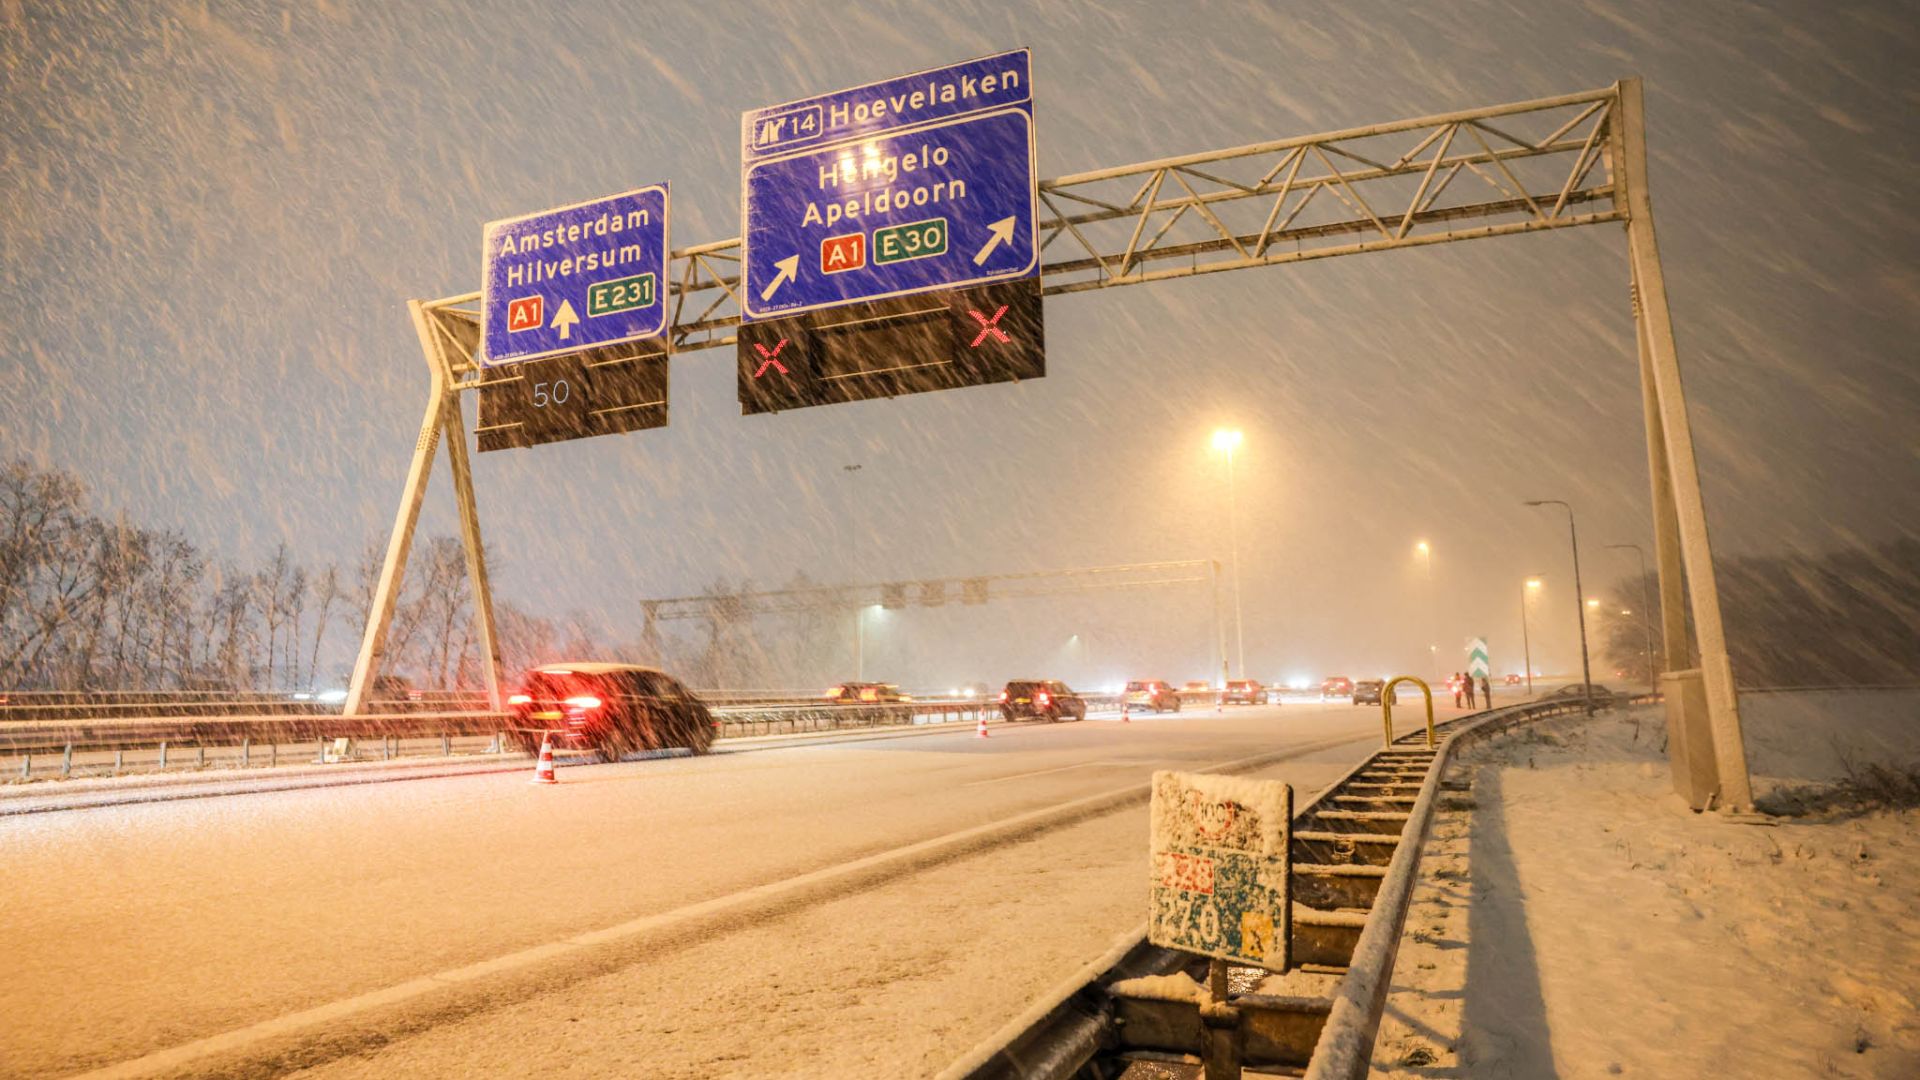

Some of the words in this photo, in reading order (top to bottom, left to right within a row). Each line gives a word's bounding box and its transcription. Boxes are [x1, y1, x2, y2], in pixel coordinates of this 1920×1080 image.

[791, 115, 816, 135] 14
[830, 69, 1019, 129] Hoevelaken
[818, 144, 949, 190] Hengelo
[801, 179, 966, 228] Apeldoorn
[500, 208, 649, 257] Amsterdam
[827, 244, 860, 266] A1
[883, 226, 941, 257] E30
[507, 244, 641, 288] Hilversum
[512, 301, 538, 326] A1
[594, 281, 650, 311] E231
[534, 379, 569, 408] 50
